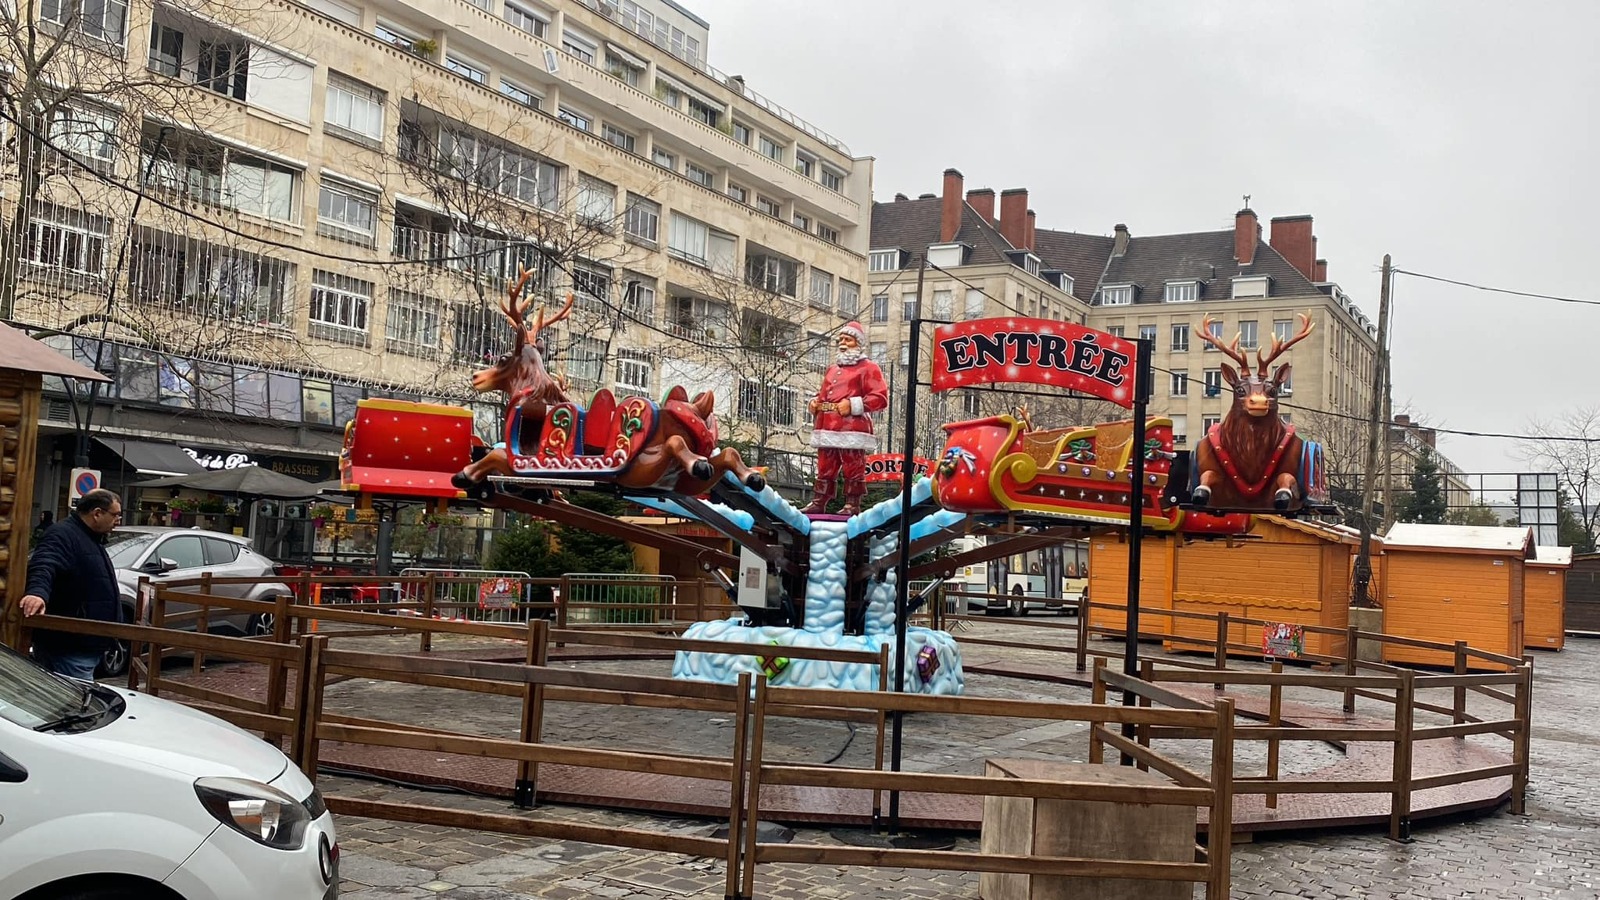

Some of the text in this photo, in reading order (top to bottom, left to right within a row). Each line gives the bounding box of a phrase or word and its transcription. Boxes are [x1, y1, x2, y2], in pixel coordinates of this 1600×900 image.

[940, 333, 1129, 387] ENTRÉE
[182, 447, 212, 468] fé
[272, 461, 319, 476] BRASSERIE
